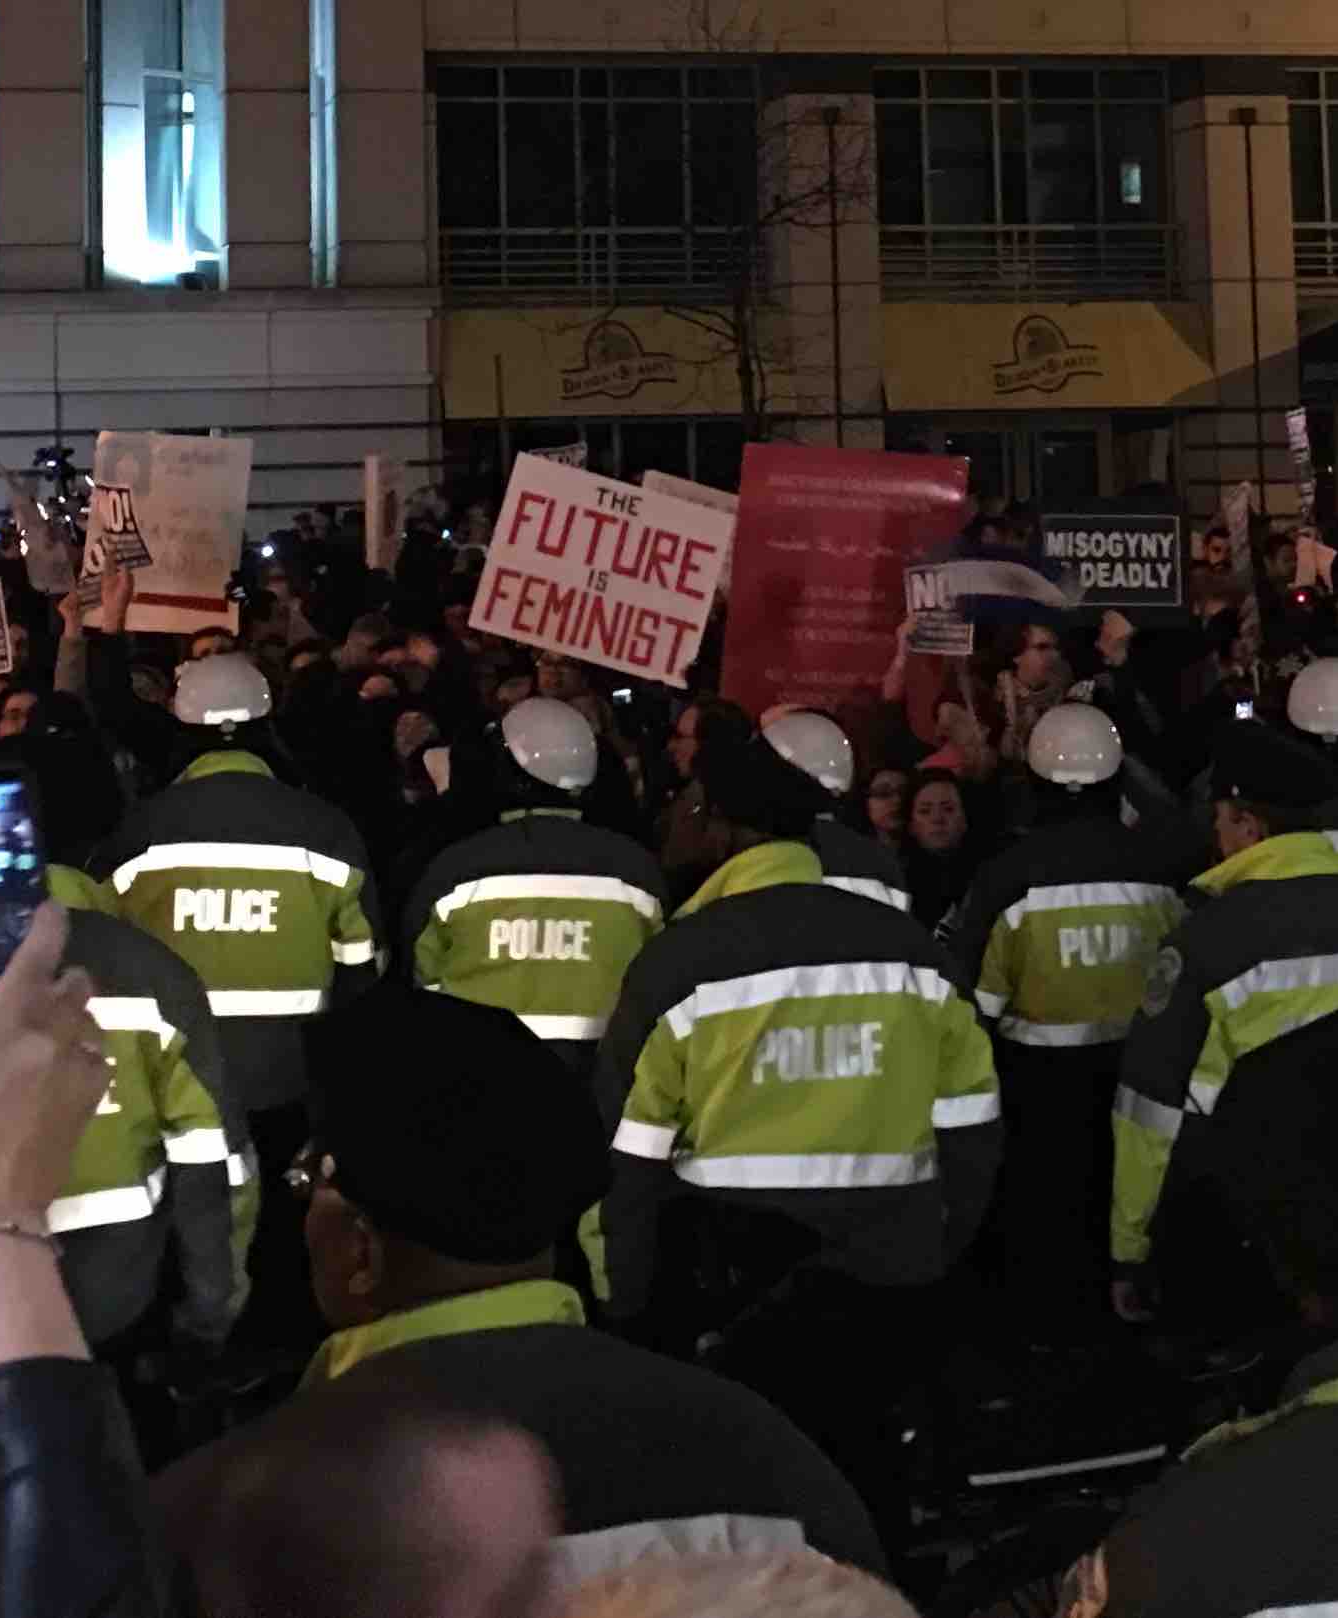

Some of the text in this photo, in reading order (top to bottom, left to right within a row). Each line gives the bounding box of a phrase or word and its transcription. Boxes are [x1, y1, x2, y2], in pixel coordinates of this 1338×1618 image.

[596, 487, 642, 516] THE
[507, 491, 717, 601] FUTURE
[1046, 531, 1173, 559] MISOGYNY
[587, 569, 610, 593] IS
[1079, 562, 1172, 589] DEADLY
[483, 567, 699, 675] FEMINIST
[173, 888, 280, 933] POLICE
[488, 919, 592, 961] POLICE
[752, 1021, 883, 1085] POLICE
